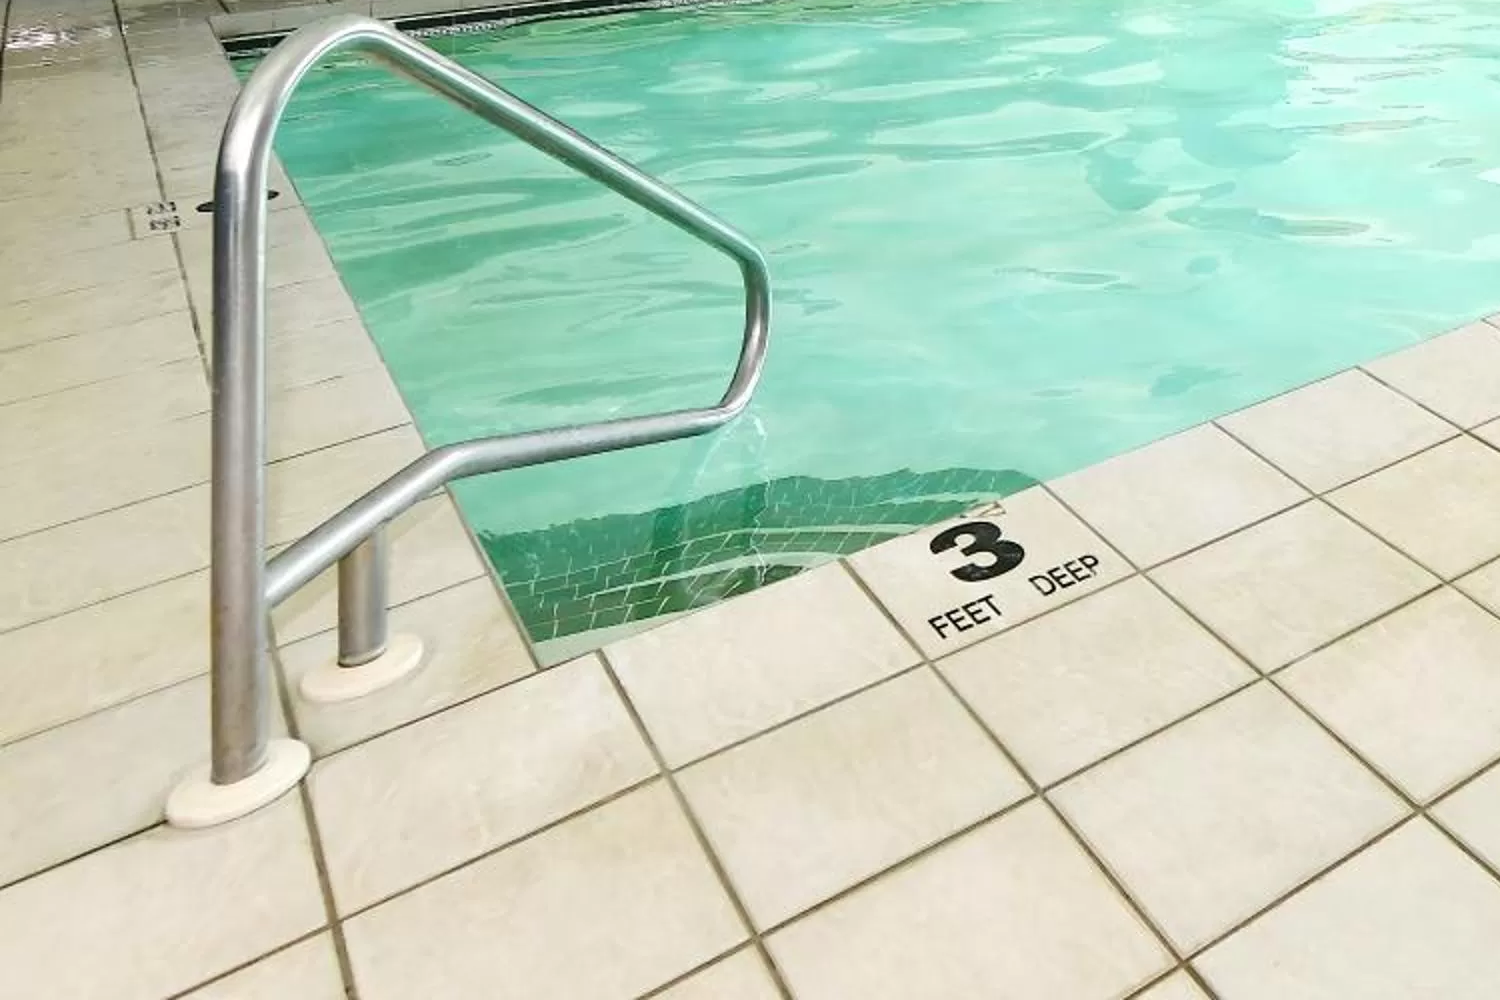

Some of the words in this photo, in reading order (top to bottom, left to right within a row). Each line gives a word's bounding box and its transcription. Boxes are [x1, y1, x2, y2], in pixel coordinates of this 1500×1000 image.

[929, 521, 1026, 583] 3
[927, 594, 1003, 639] FEET
[1027, 554, 1100, 597] DEEP
